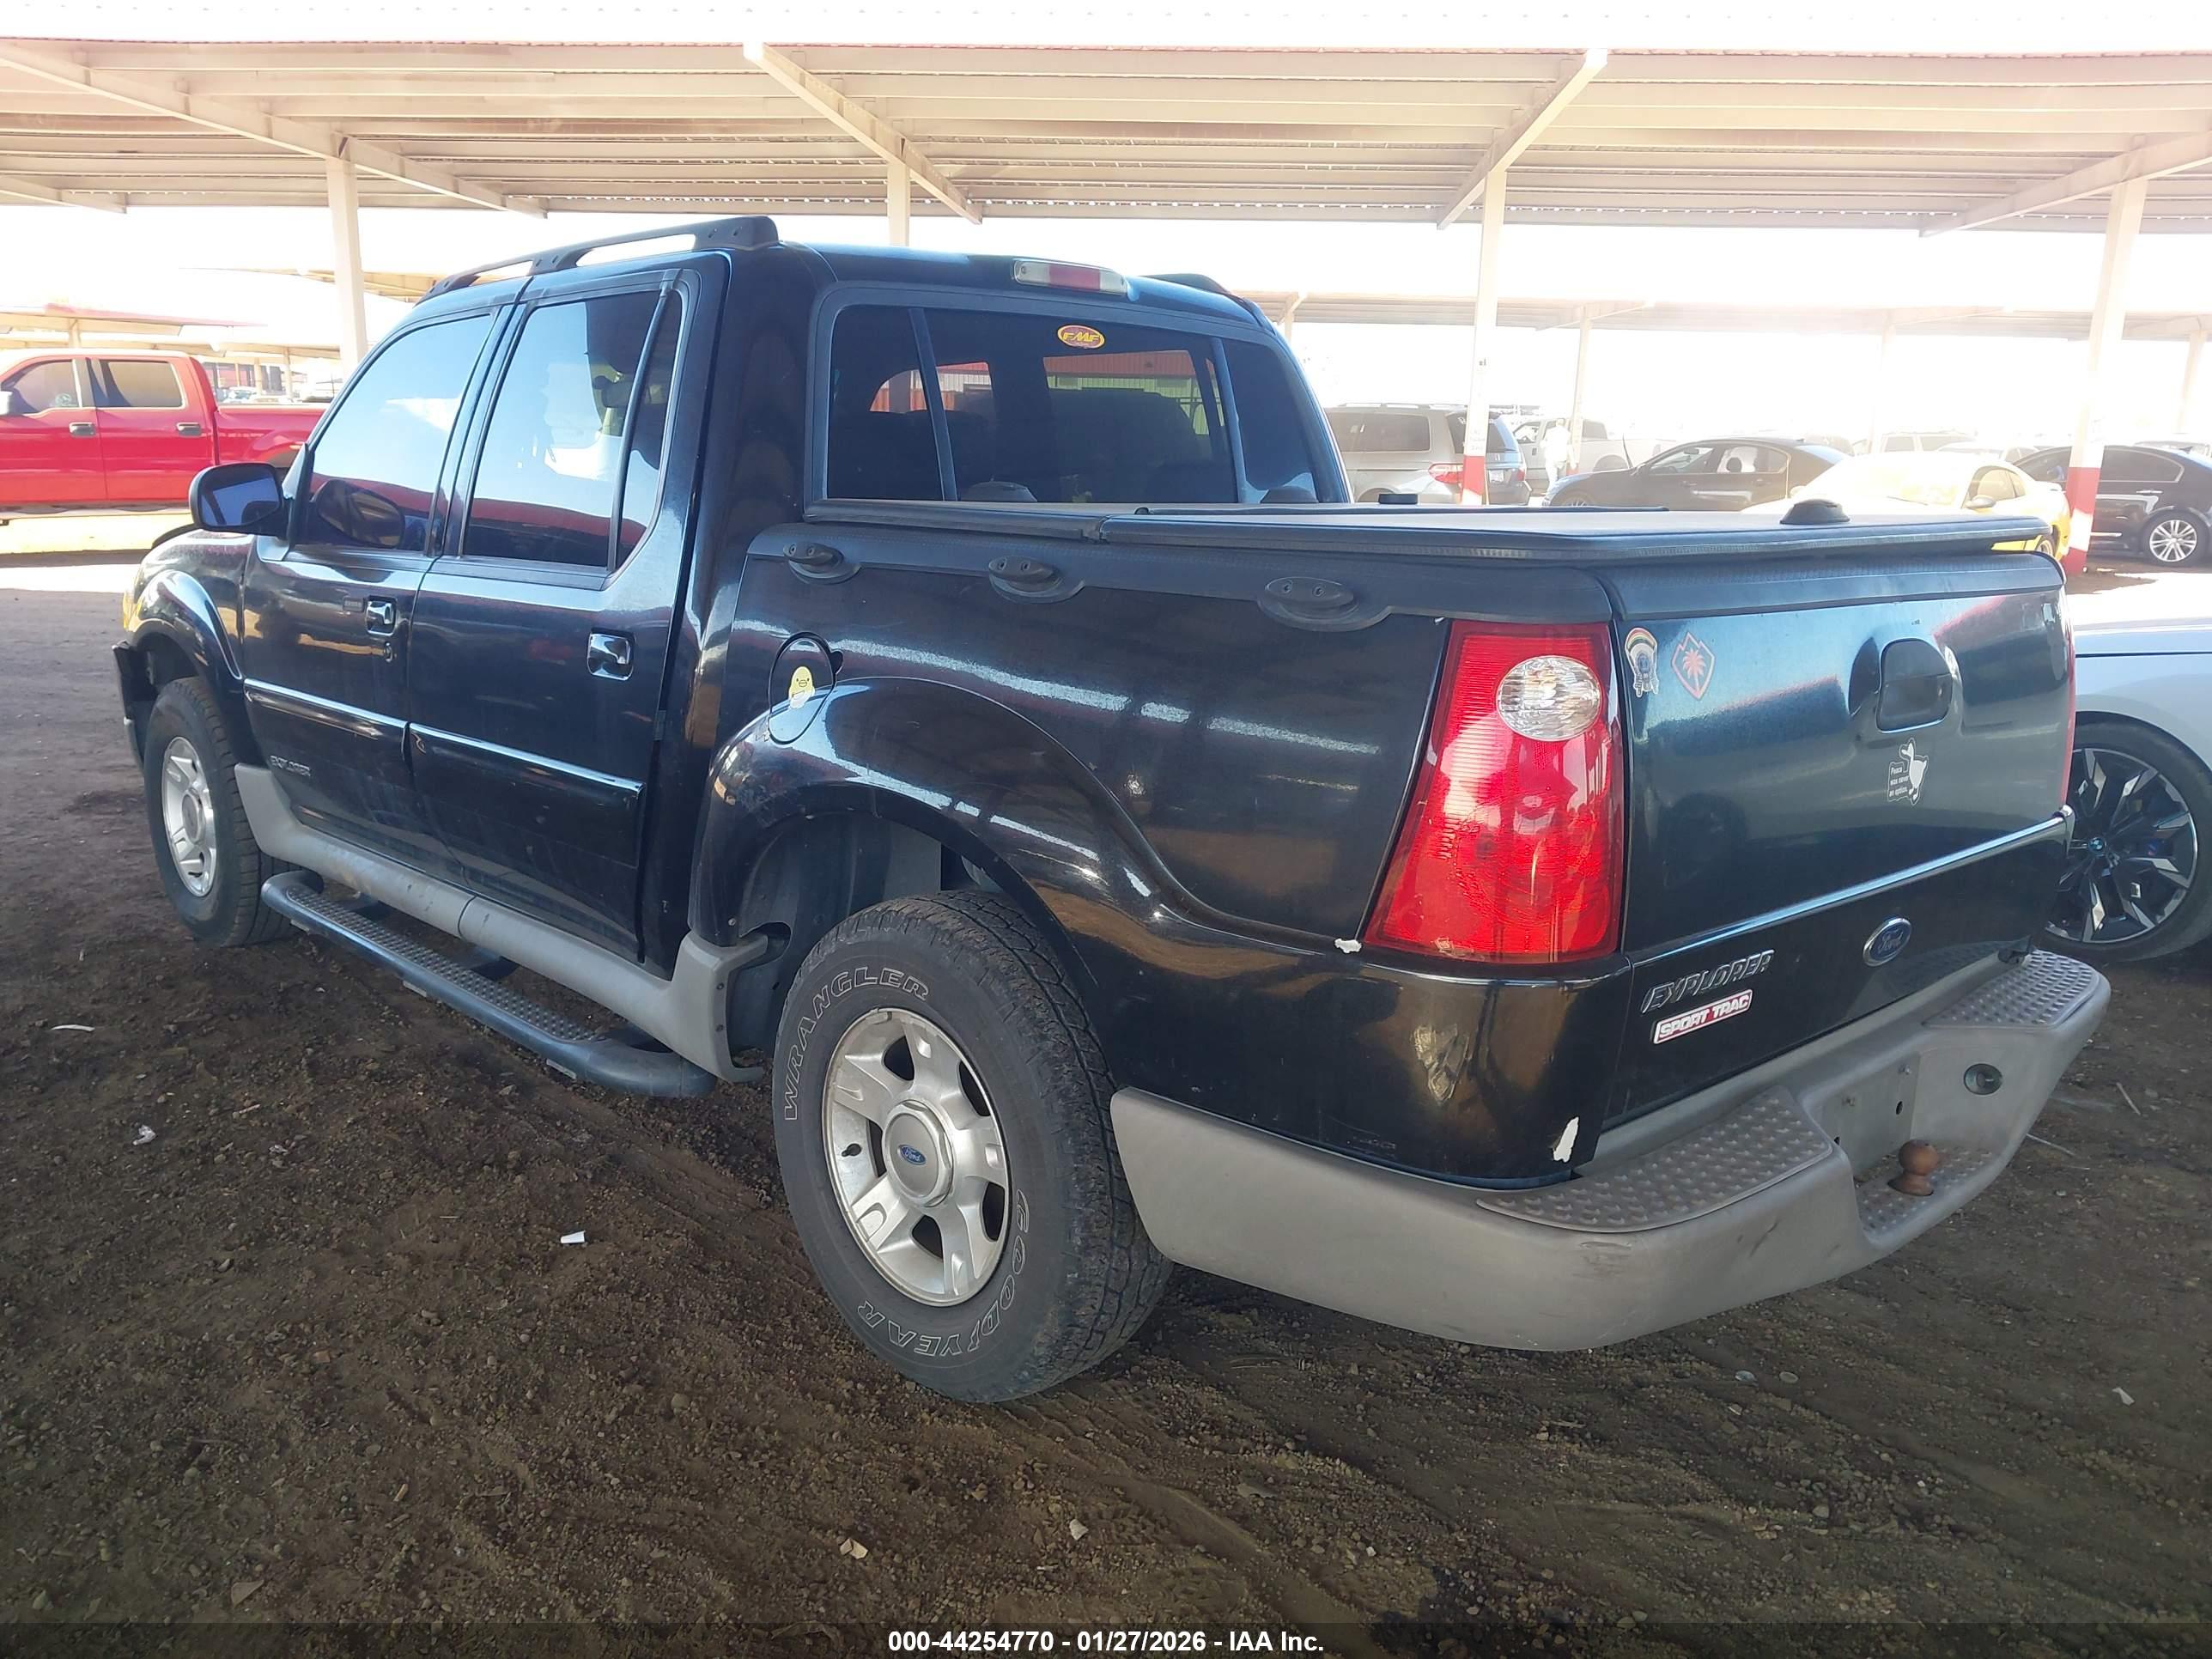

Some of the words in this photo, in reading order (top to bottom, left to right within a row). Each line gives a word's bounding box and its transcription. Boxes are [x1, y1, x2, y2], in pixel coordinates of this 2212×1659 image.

[1062, 331, 1100, 343] FMF
[1640, 949, 1775, 1014] EXPLORER
[784, 966, 929, 1121] WRANGLER
[1658, 1008, 1710, 1038] SPORT
[1711, 994, 1750, 1019] TRAC
[857, 1188, 1030, 1357] GOODYEAR
